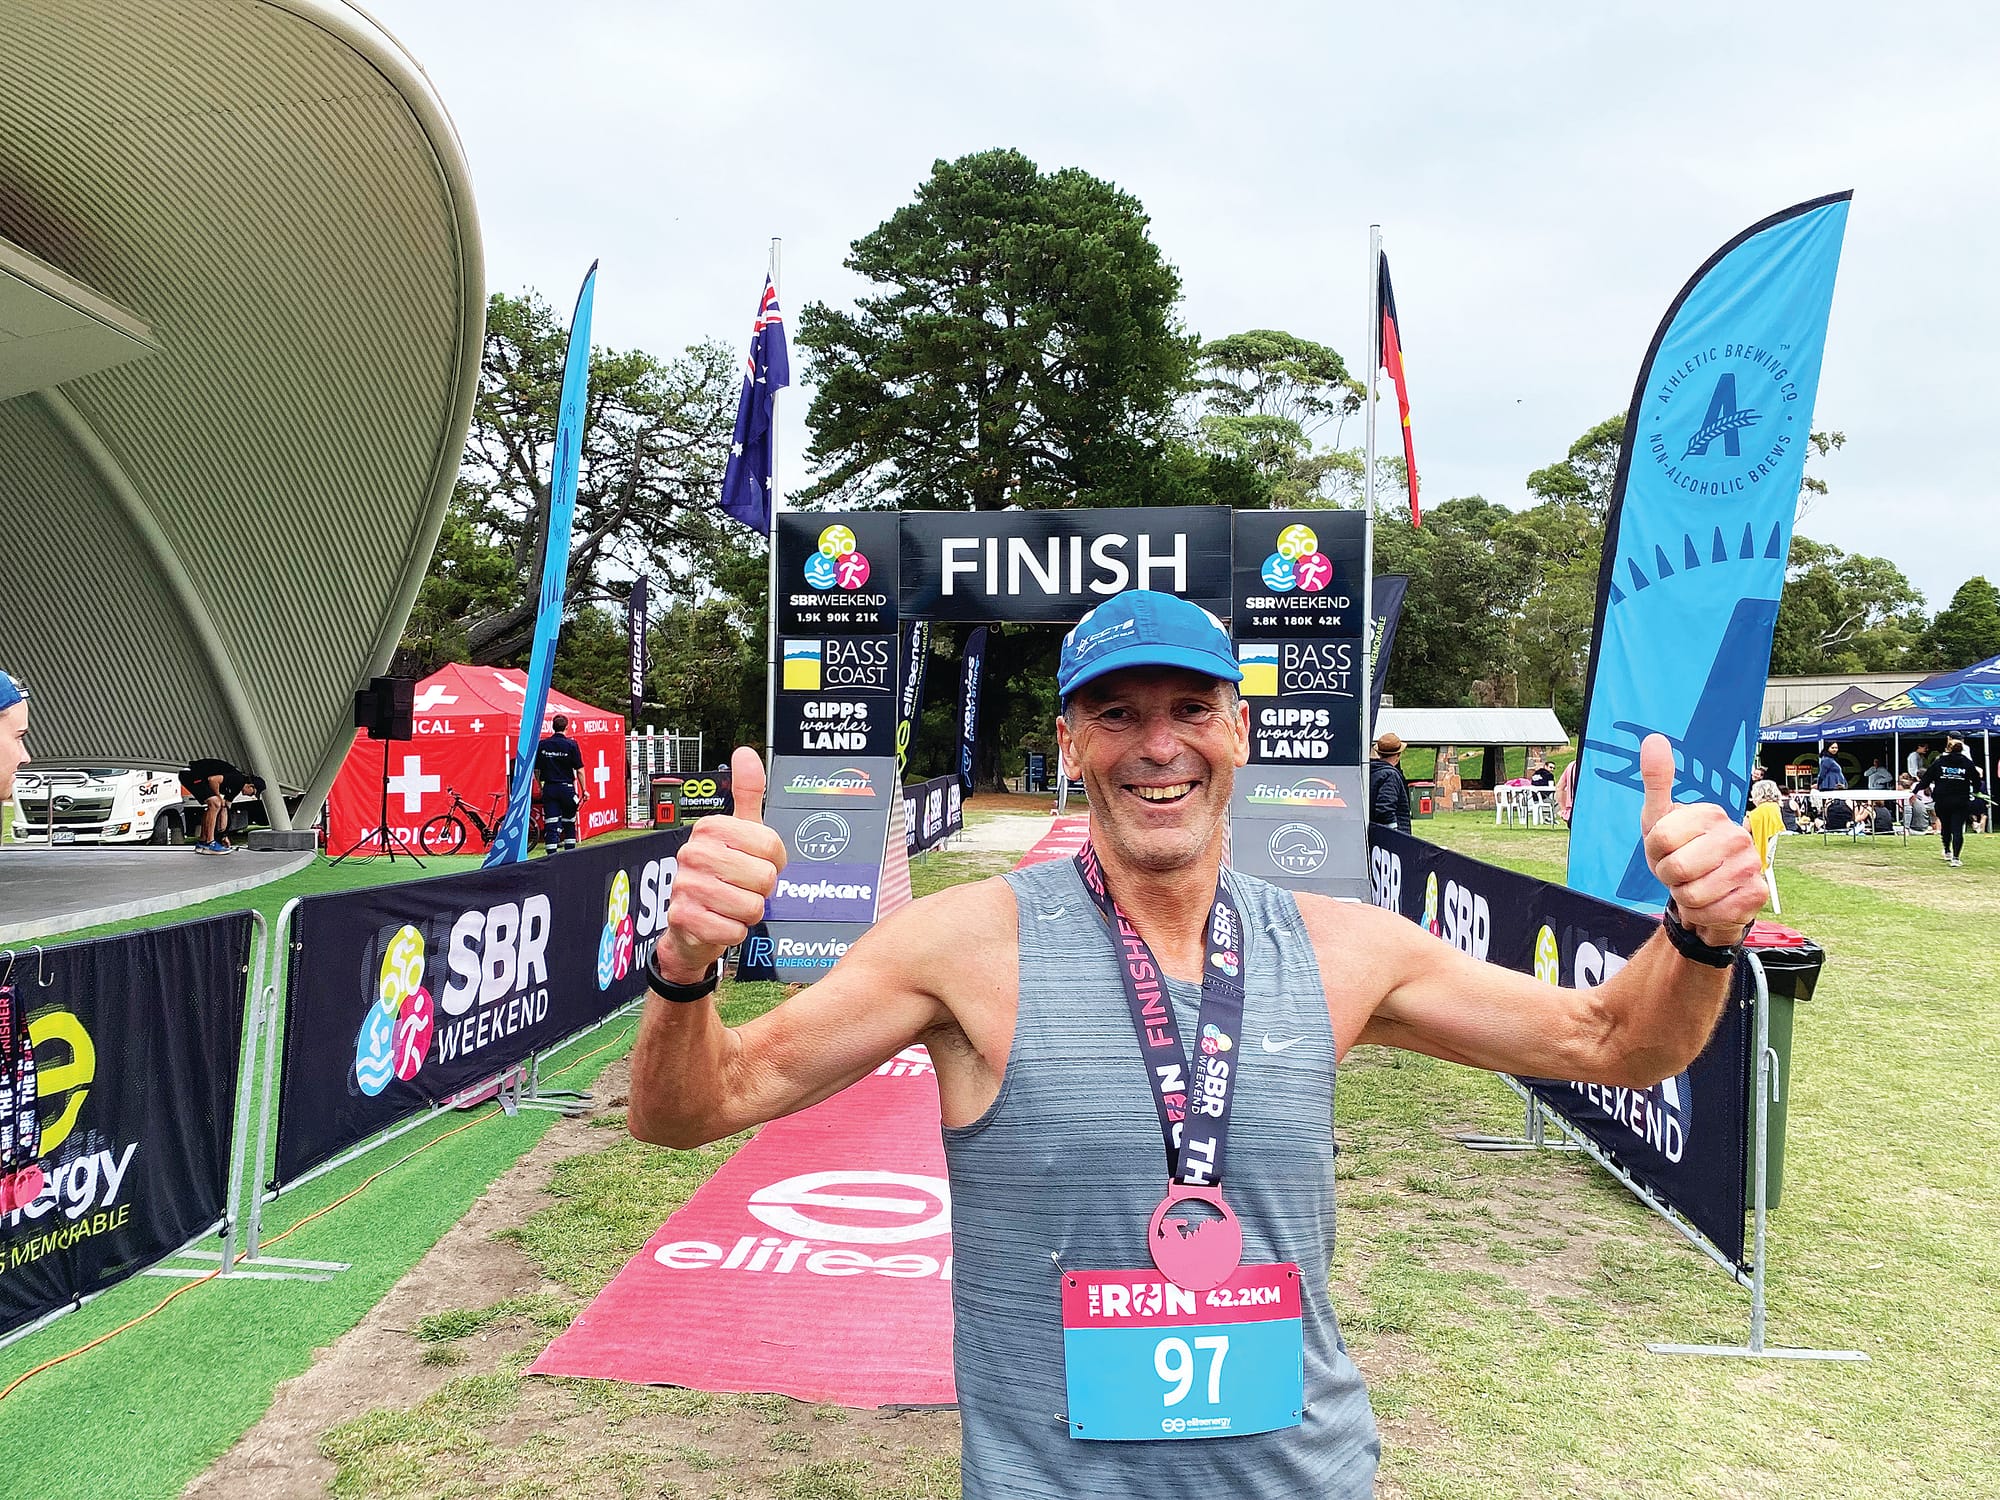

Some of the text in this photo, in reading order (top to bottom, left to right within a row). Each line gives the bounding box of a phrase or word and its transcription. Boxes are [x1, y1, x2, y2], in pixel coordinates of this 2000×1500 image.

[1658, 347, 1717, 404] ATHLETIC
[1725, 343, 1789, 381] BREWING
[1649, 433, 1791, 496] NON-ALCOHOLIC BREWS
[941, 533, 1187, 597] FINISH
[796, 612, 879, 623] 1.9K 90K 21K
[1252, 615, 1342, 627] 3.8K 180K 42K
[632, 607, 643, 698] BAGGAGE
[826, 640, 888, 664] BASS
[1370, 615, 1387, 668] MEMORABLE
[1285, 644, 1352, 671] BASS
[826, 667, 888, 684] COAST
[1284, 672, 1351, 691] COAST
[803, 702, 868, 719] GIPPS
[1260, 708, 1330, 728] GIPPS
[584, 720, 609, 733] MEDICAL
[800, 715, 872, 731] wonder
[1256, 725, 1335, 740] wonder
[803, 732, 867, 750] LAND
[1259, 740, 1330, 759] LAND
[791, 773, 868, 789] fisiocrem
[1253, 783, 1336, 800] fisiocrem
[588, 809, 618, 829] MEDICAL
[803, 843, 837, 853] ITTA
[1280, 856, 1317, 867] ITTA
[776, 880, 872, 904] Peoplecare
[1371, 845, 1402, 915] SBR
[636, 856, 679, 937] SB
[1212, 901, 1232, 951] SBR
[1229, 909, 1239, 953] WEEKEND
[1442, 880, 1491, 962] SBR
[441, 893, 551, 1016] SBR
[776, 958, 819, 967] ENERGY
[437, 988, 549, 1064] WEEKEND
[1191, 1054, 1208, 1116] WEEKEND
[1200, 1056, 1230, 1119] SBR
[1088, 1283, 1281, 1317] THE RUN 42.2KM
[1154, 1335, 1230, 1408] 97
